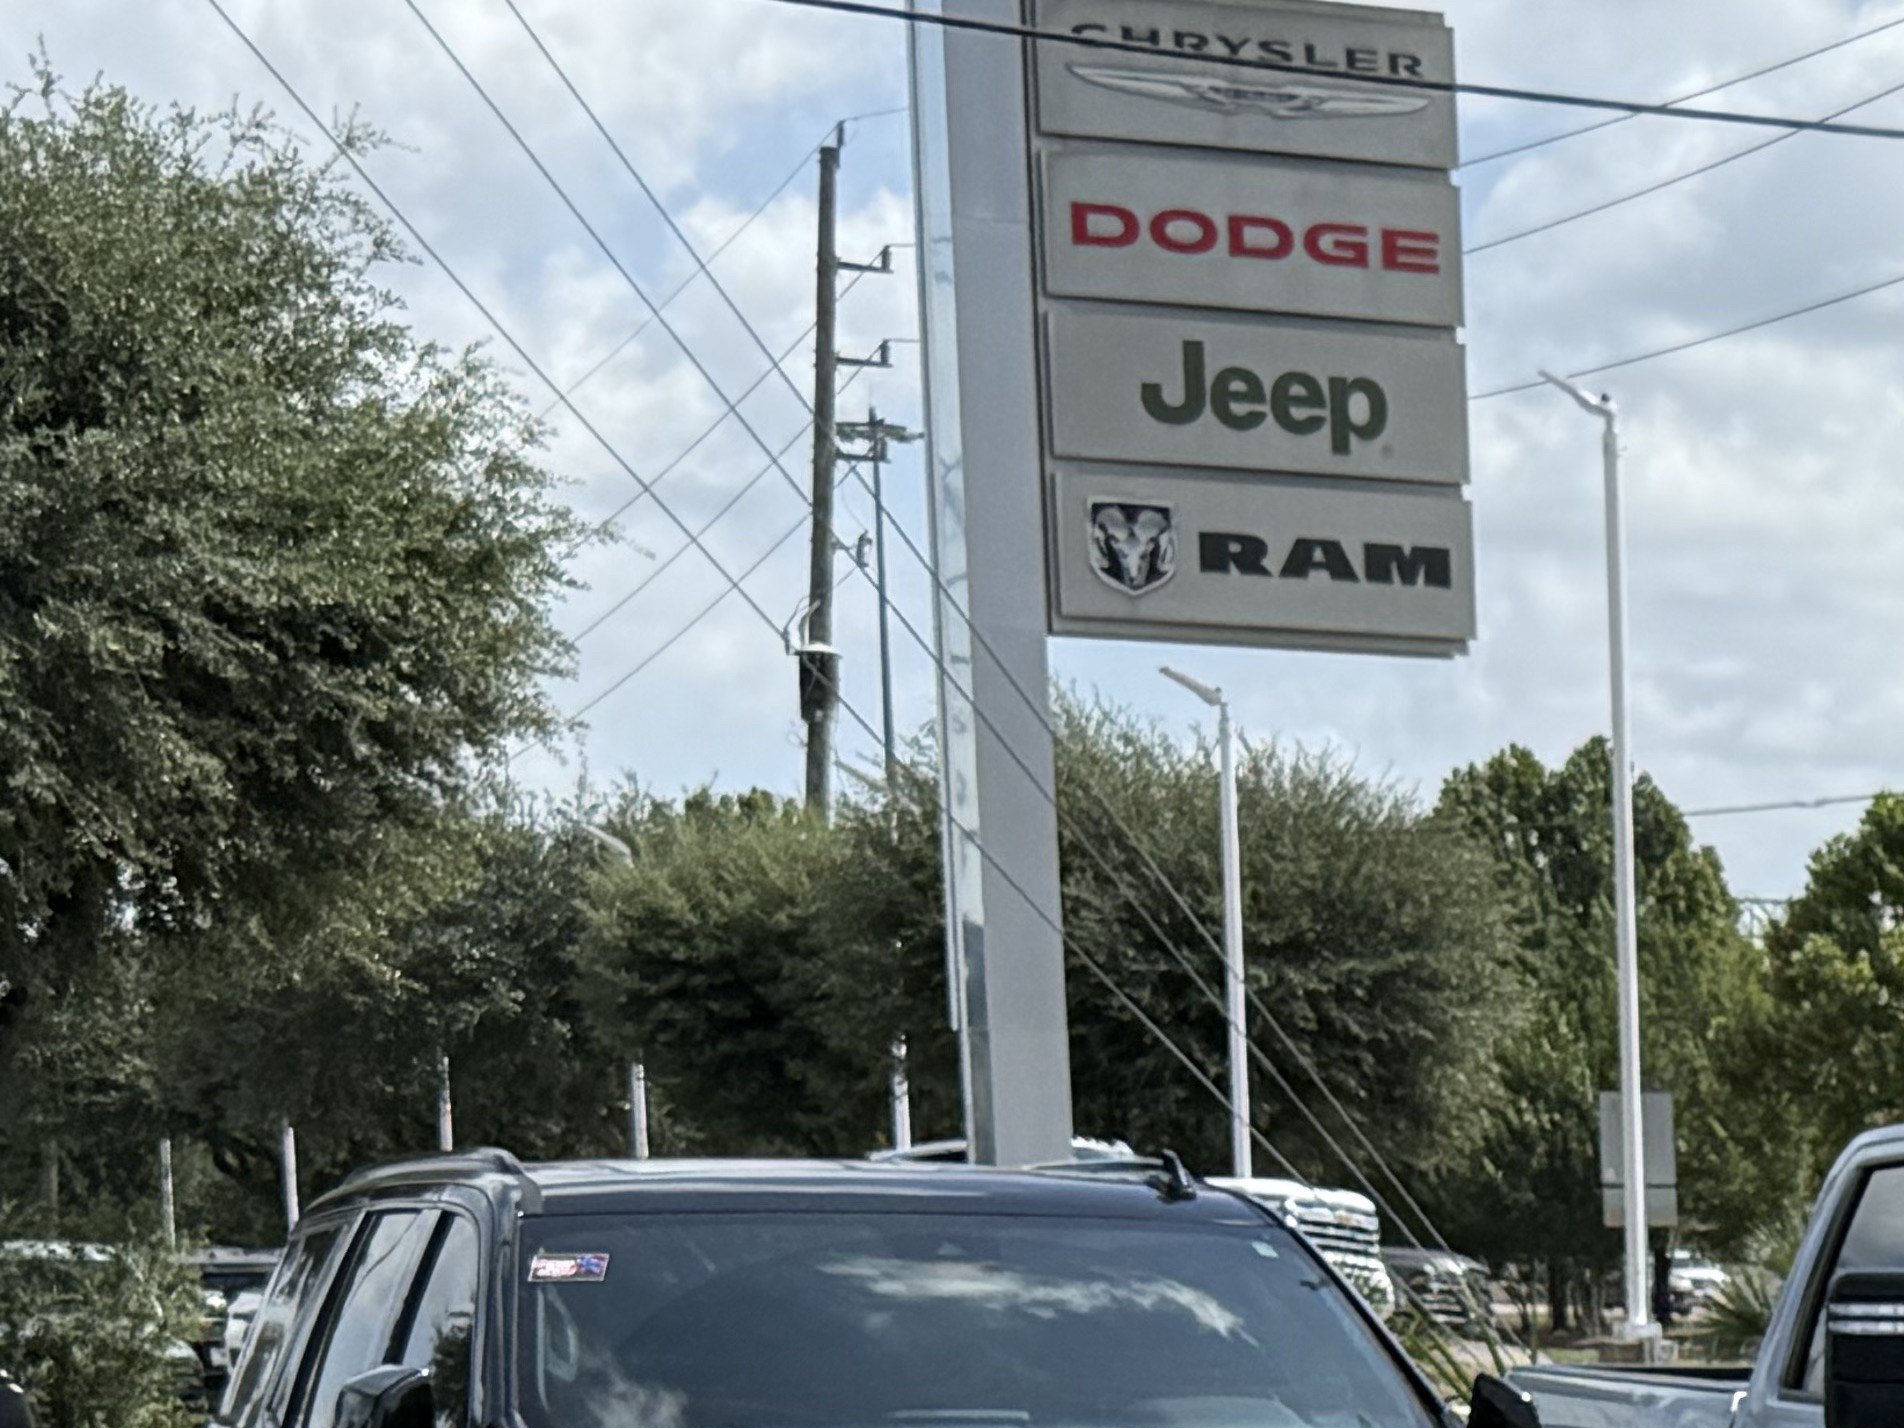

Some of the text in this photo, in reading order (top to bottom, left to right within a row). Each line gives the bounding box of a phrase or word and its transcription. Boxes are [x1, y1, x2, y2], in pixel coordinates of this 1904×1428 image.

[1070, 201, 1441, 274] DODGE
[1140, 340, 1388, 455] Jeep
[1198, 530, 1452, 589] RAM
